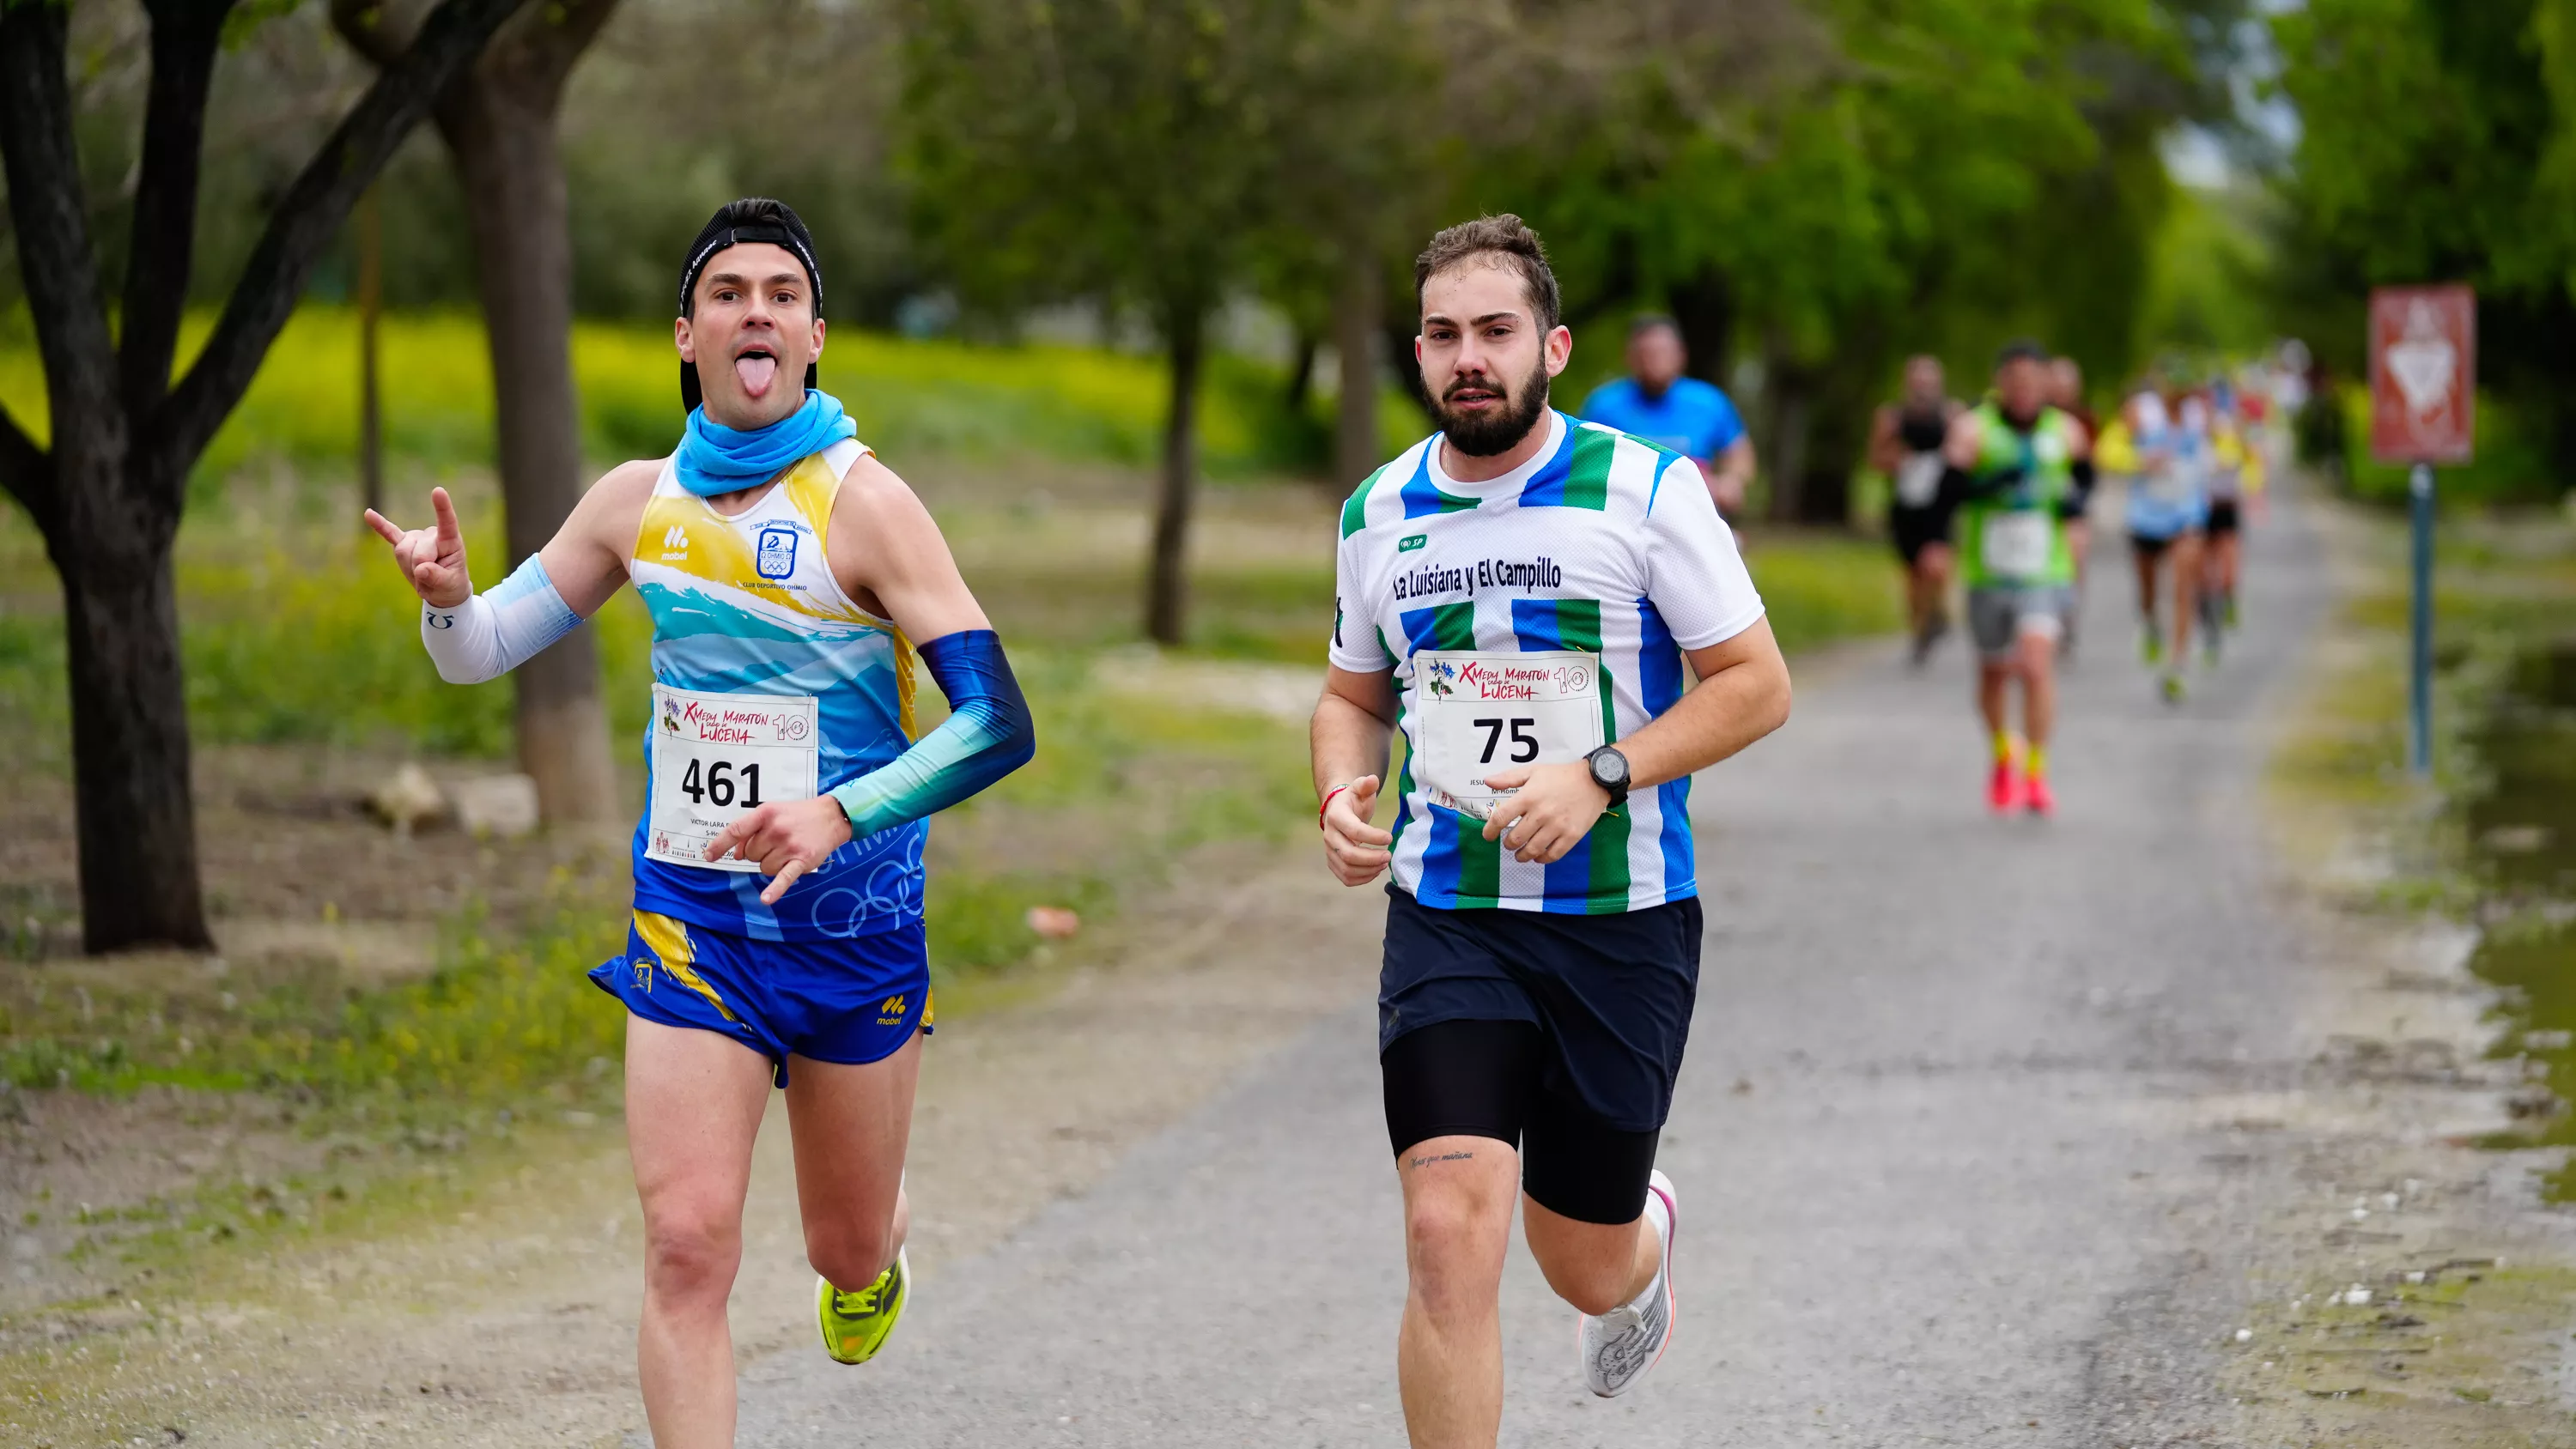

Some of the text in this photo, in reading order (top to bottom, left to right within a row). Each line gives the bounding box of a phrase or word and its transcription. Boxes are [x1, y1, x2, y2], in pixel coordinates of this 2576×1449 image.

[660, 550, 688, 561] mobel
[1393, 555, 1561, 601] La Luisiana y El Campillo
[1504, 667, 1550, 682] MARATÓN
[1481, 682, 1540, 700] LUCENA
[723, 710, 769, 725] MARATÓN
[700, 722, 757, 745] LUCENA
[1473, 718, 1540, 764] 75
[682, 758, 764, 809] 461
[690, 818, 709, 827] VICTOR
[876, 1016, 902, 1025] mobel
[1441, 1150, 1473, 1161] mañana
